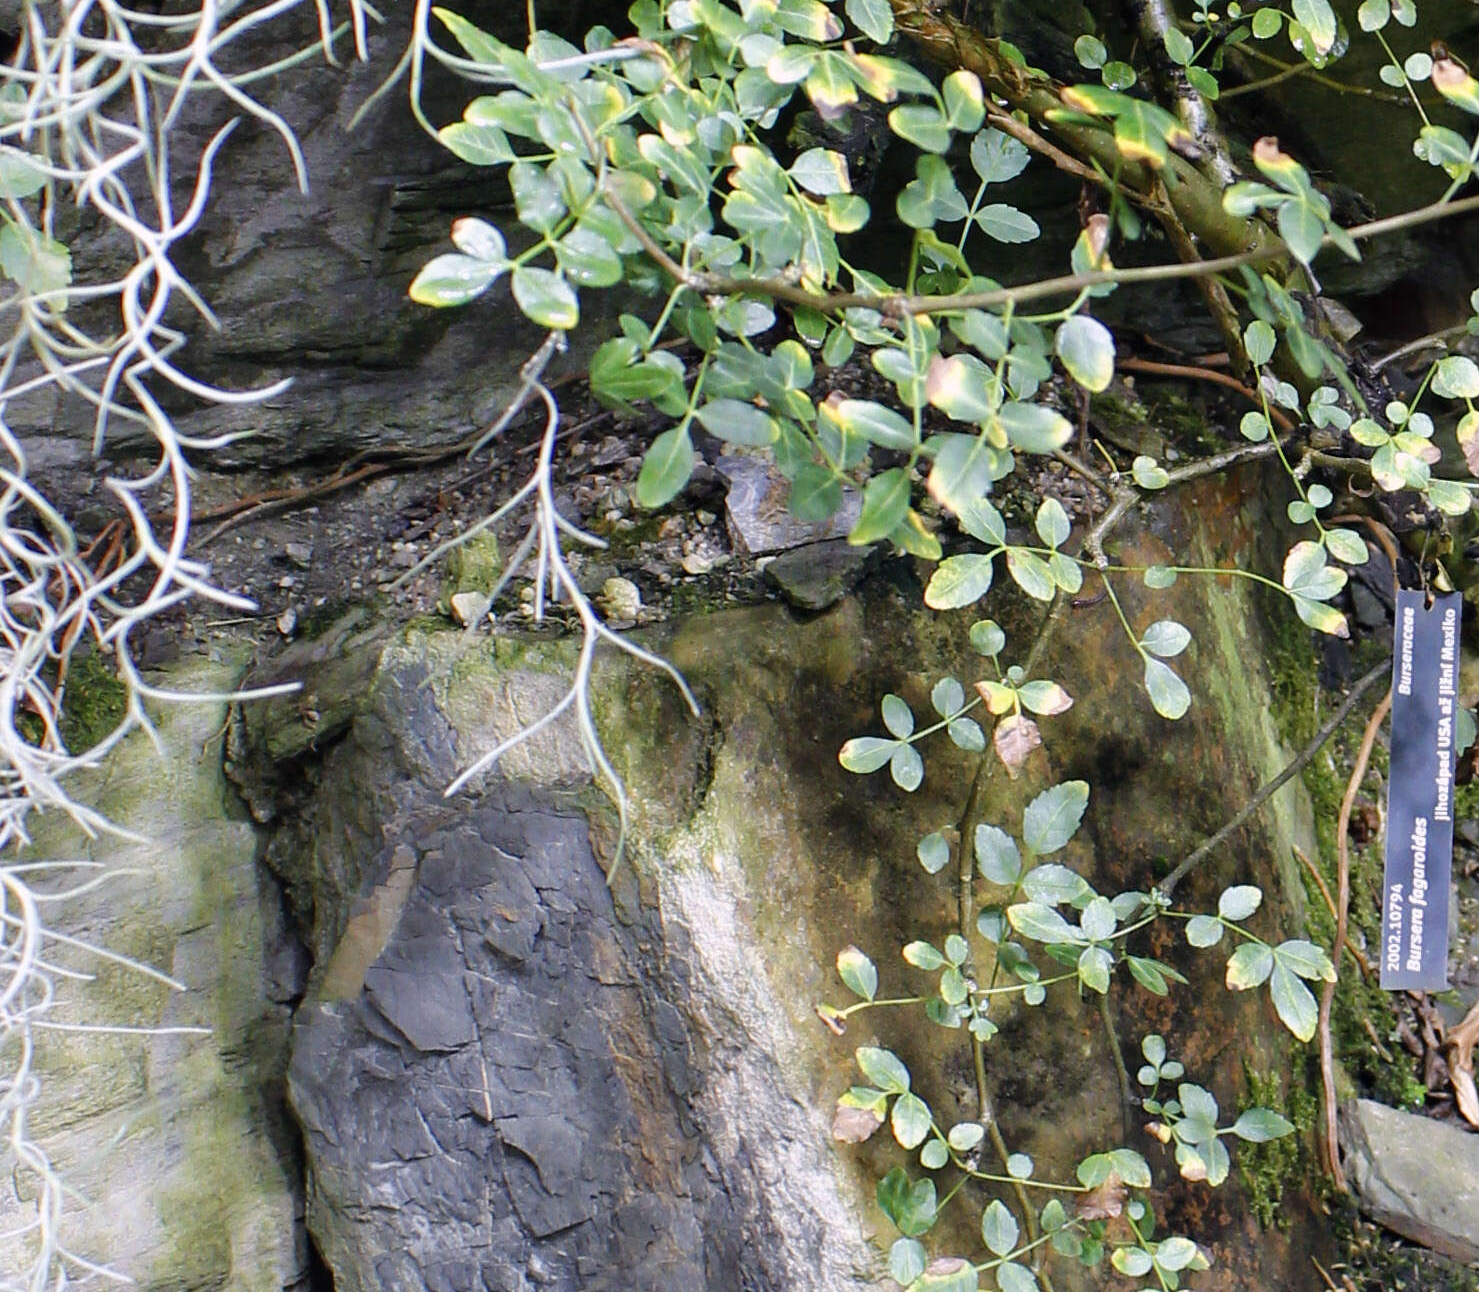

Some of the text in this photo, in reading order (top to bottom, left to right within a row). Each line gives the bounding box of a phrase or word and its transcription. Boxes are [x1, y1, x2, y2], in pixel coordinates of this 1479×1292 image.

[1398, 607, 1415, 696] Burseraceae
[1434, 608, 1456, 821] jihozápad USA až jižní Mexiko
[1387, 883, 1404, 972] 2002.10794
[1406, 816, 1428, 972] Bursera fagaroides
